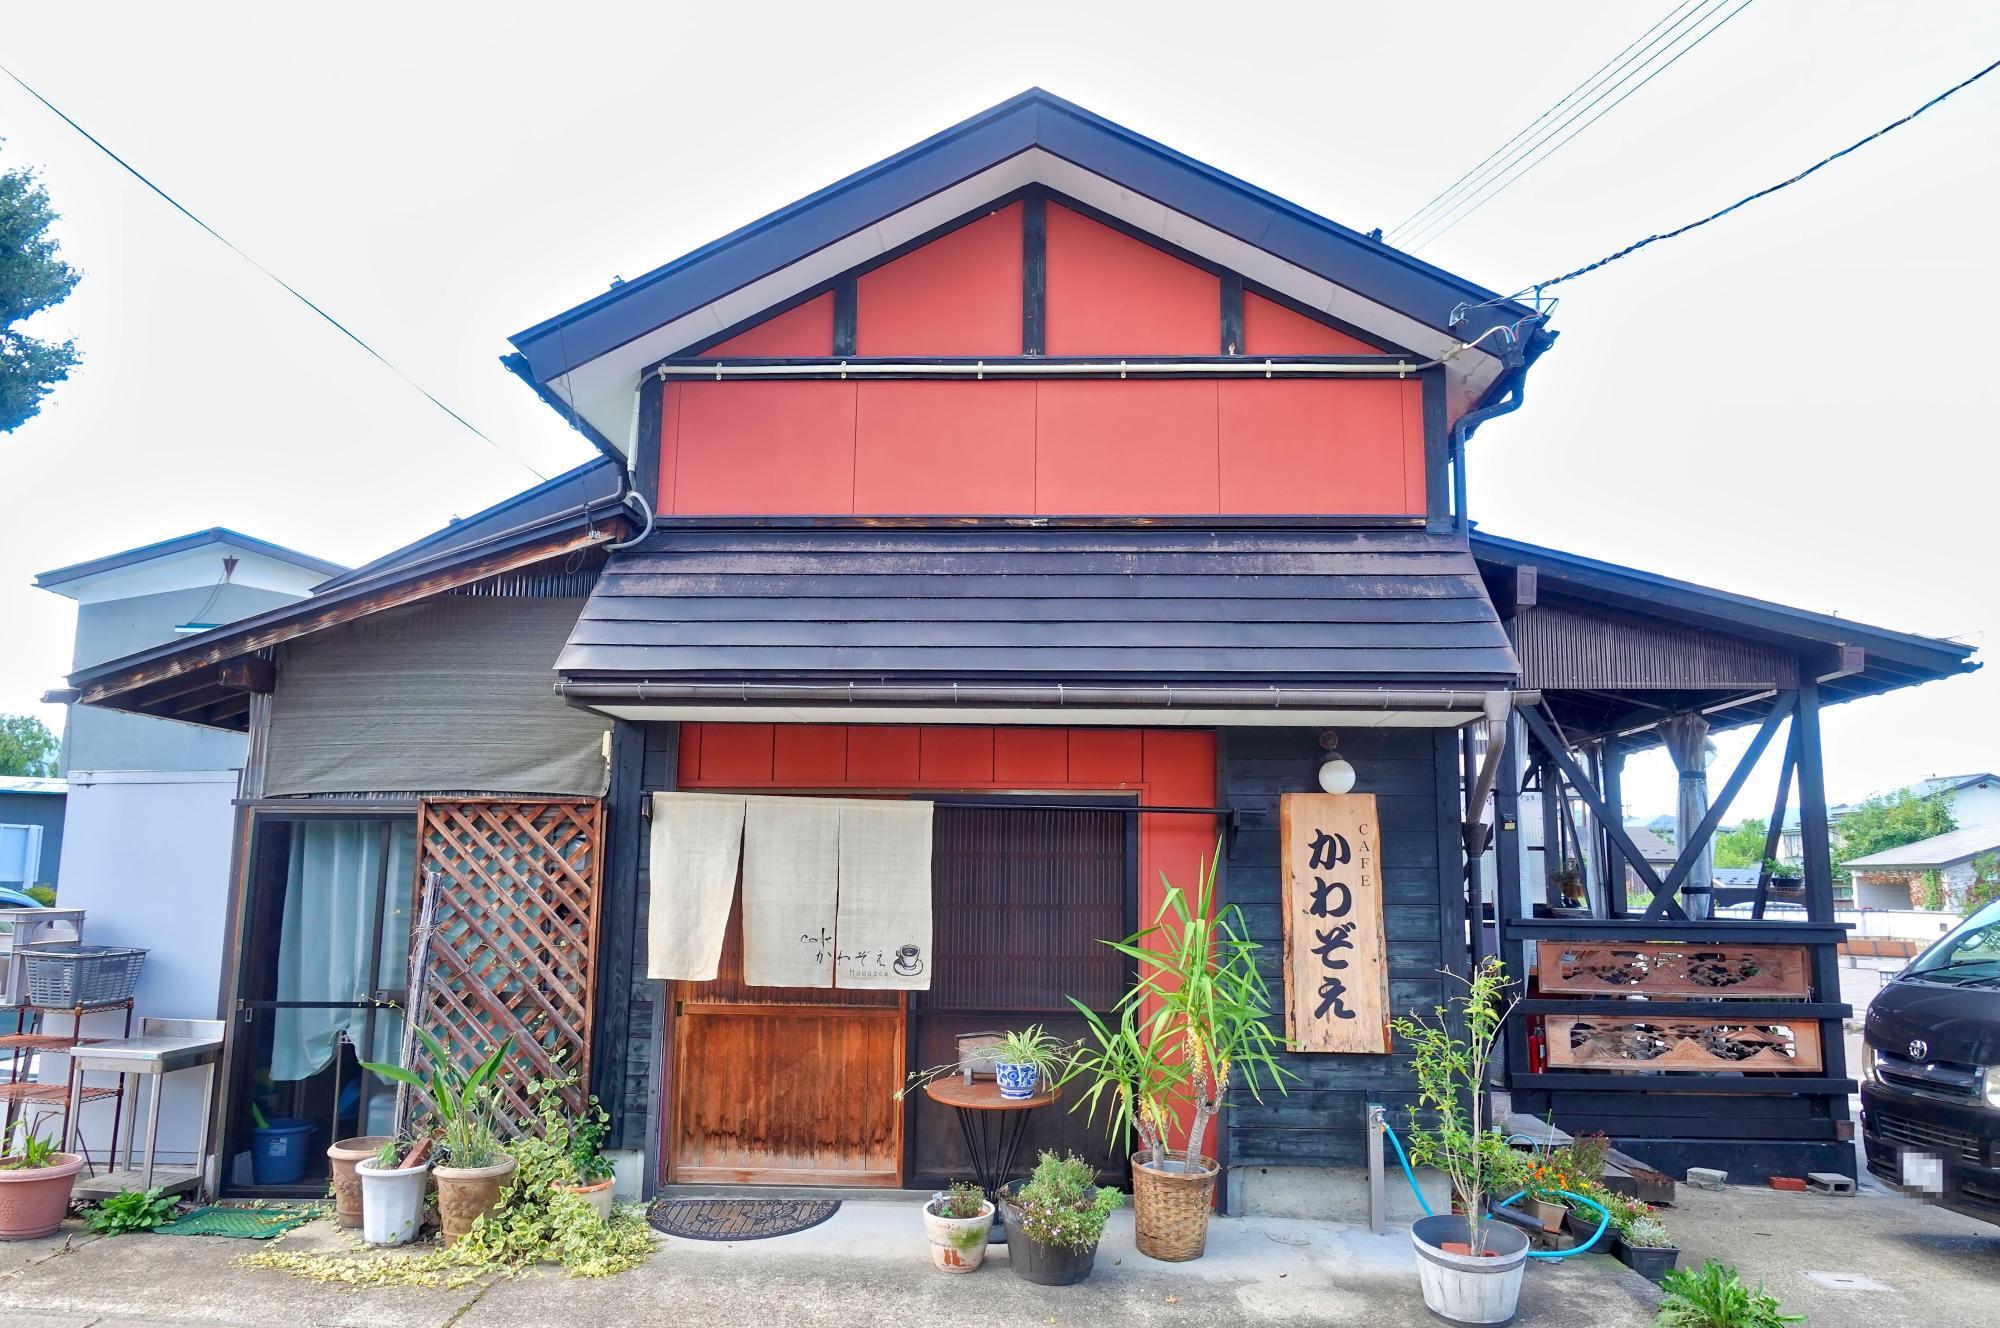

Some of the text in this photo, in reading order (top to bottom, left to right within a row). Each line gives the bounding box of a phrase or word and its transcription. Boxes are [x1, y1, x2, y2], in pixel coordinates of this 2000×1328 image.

[1358, 823, 1371, 887] CAFE
[1307, 827, 1357, 1020] かわぞえ
[815, 949, 886, 968] かわぞえ
